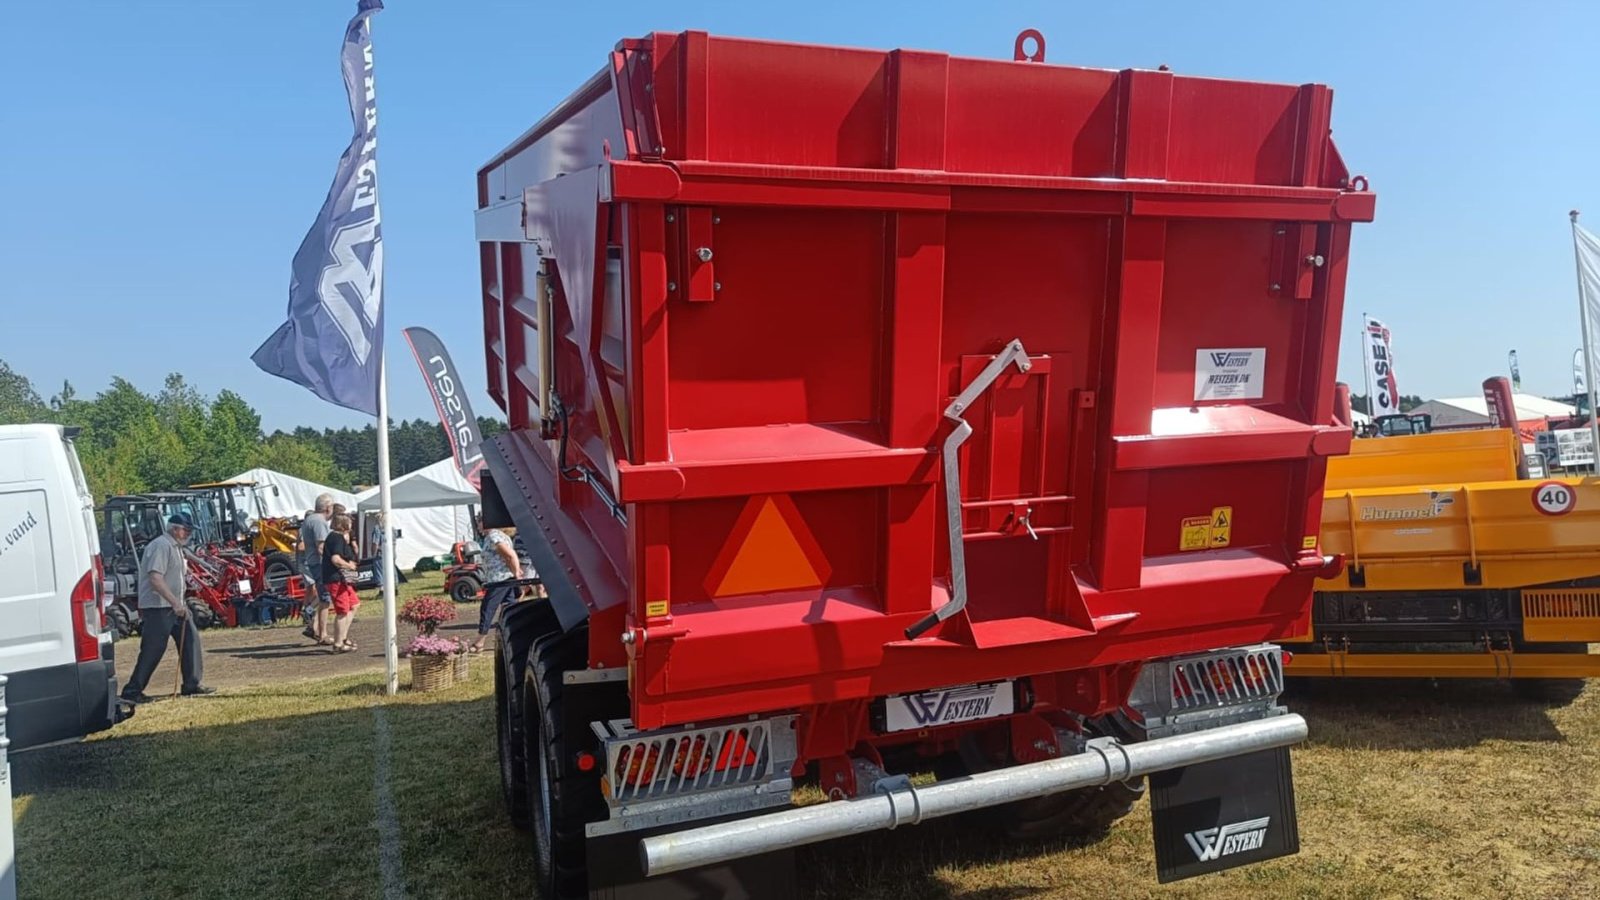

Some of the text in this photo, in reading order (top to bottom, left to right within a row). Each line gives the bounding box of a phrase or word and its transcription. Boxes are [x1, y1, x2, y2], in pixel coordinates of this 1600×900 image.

[1210, 352, 1249, 367] WESTERN
[1208, 374, 1238, 384] WESTERN
[1372, 345, 1390, 408] CASE
[1540, 490, 1567, 505] 40
[1361, 504, 1436, 520] Hummel
[902, 691, 994, 725] WESTERN
[1184, 827, 1267, 862] WESTERN
